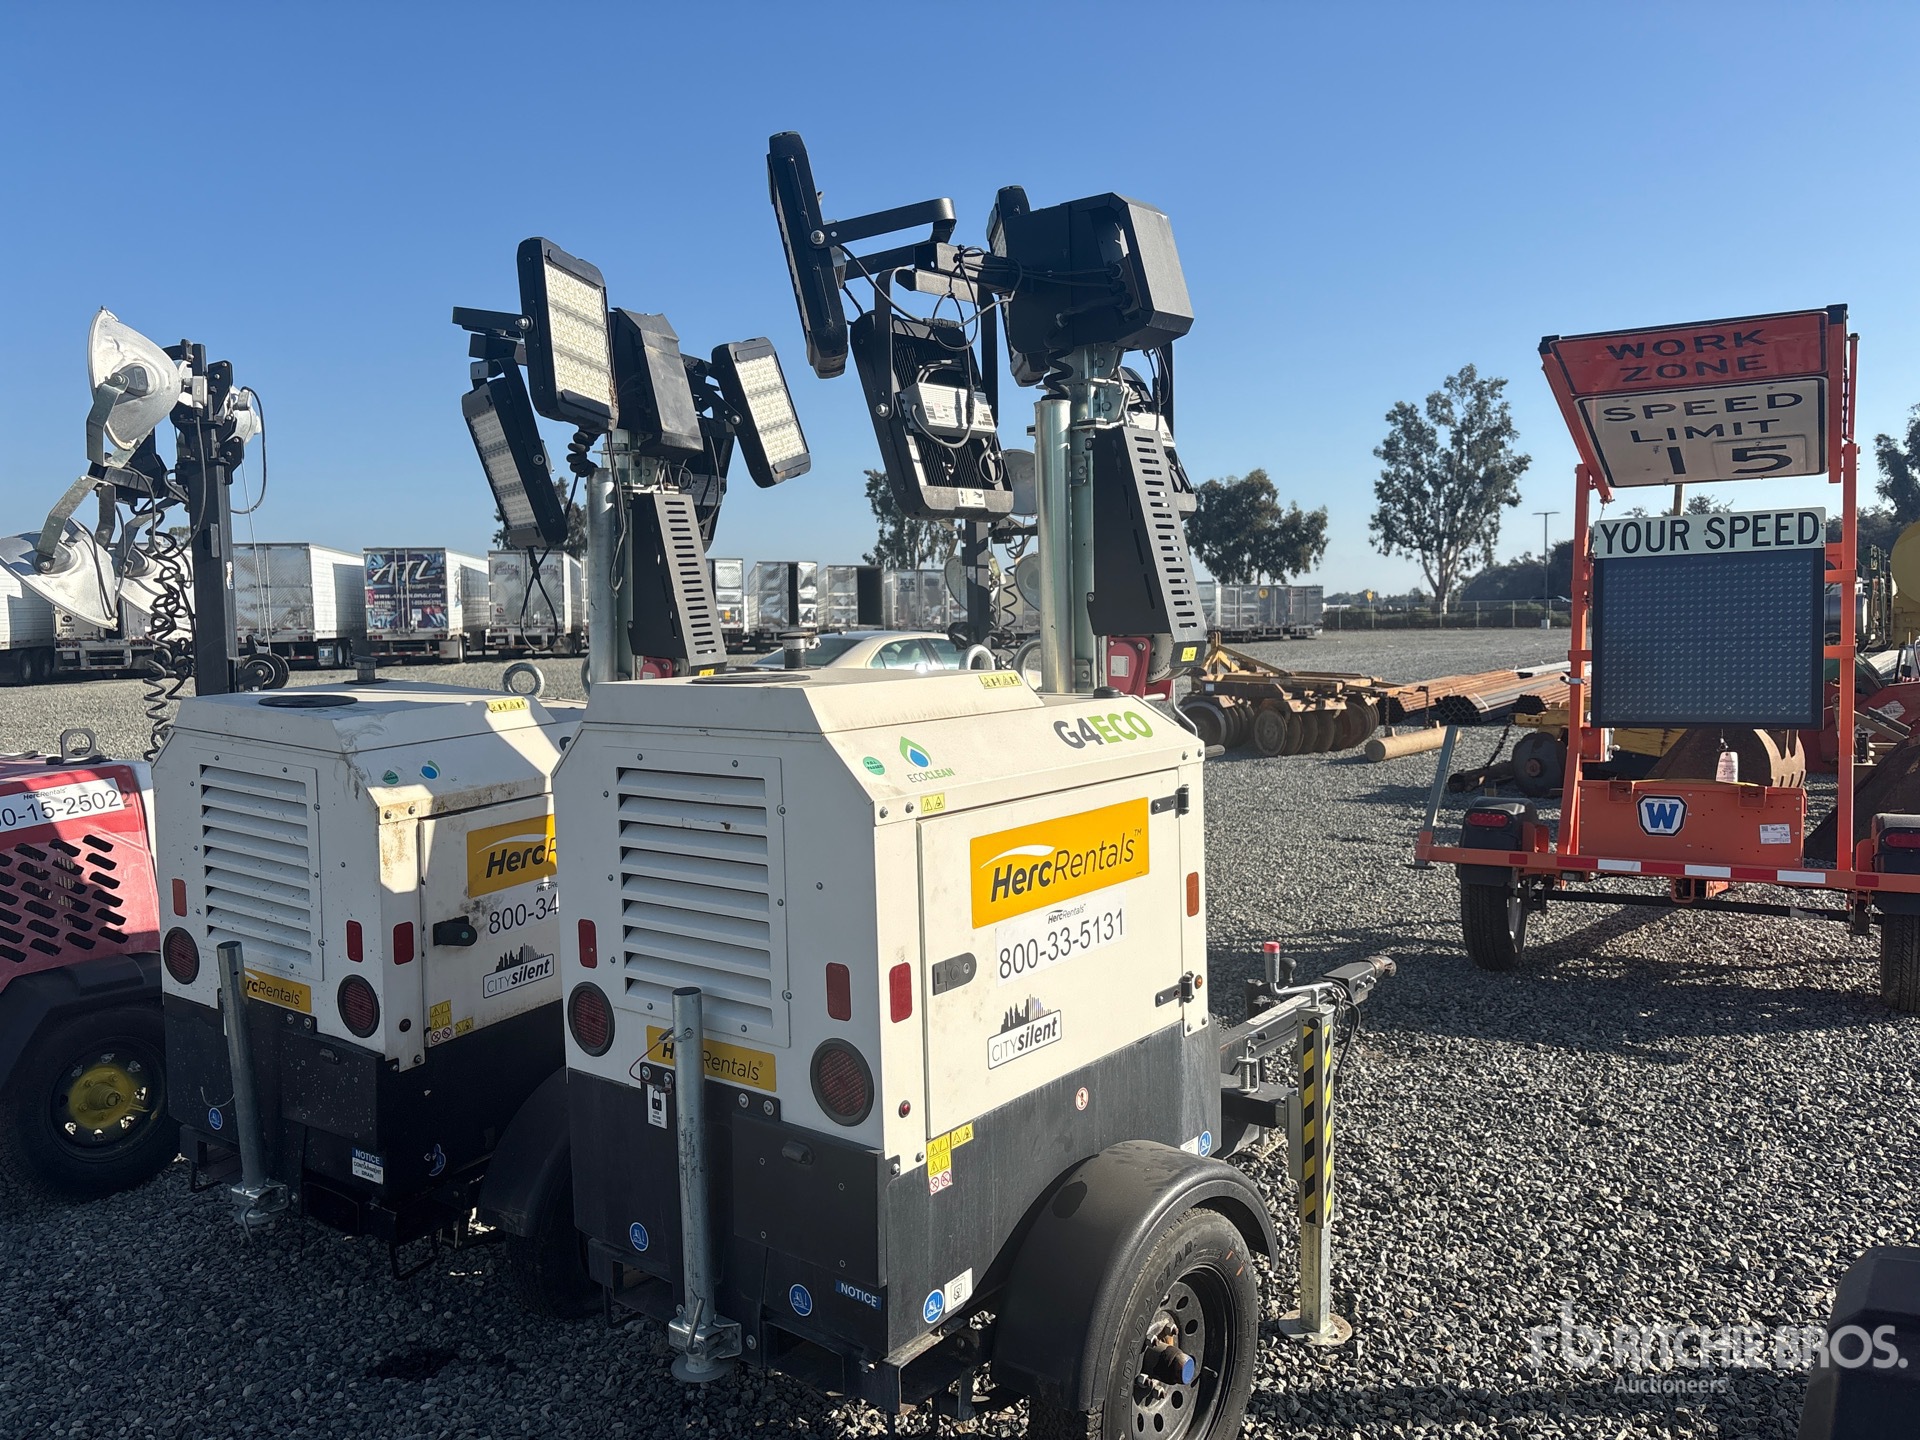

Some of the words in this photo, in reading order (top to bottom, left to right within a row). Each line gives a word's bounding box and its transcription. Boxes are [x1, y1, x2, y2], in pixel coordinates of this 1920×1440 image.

[1605, 329, 1768, 360] WORK
[1619, 353, 1768, 383] ZONE
[1603, 392, 1803, 422] SPEED
[1630, 418, 1781, 444] LIMIT
[1600, 518, 1690, 555] YOUR
[1704, 511, 1820, 550] SPEED
[373, 560, 436, 584] ATL
[1053, 711, 1154, 749] G4ECO
[907, 767, 956, 784] ECOCLEAN
[0, 789, 121, 827] 0-15-2502
[1645, 802, 1680, 829] W
[990, 833, 1135, 903] HercRentals
[999, 908, 1124, 979] 800-33-5131
[245, 980, 300, 1005] rcRentals
[355, 1149, 380, 1165] NOTICE
[840, 1282, 878, 1308] NOTICE
